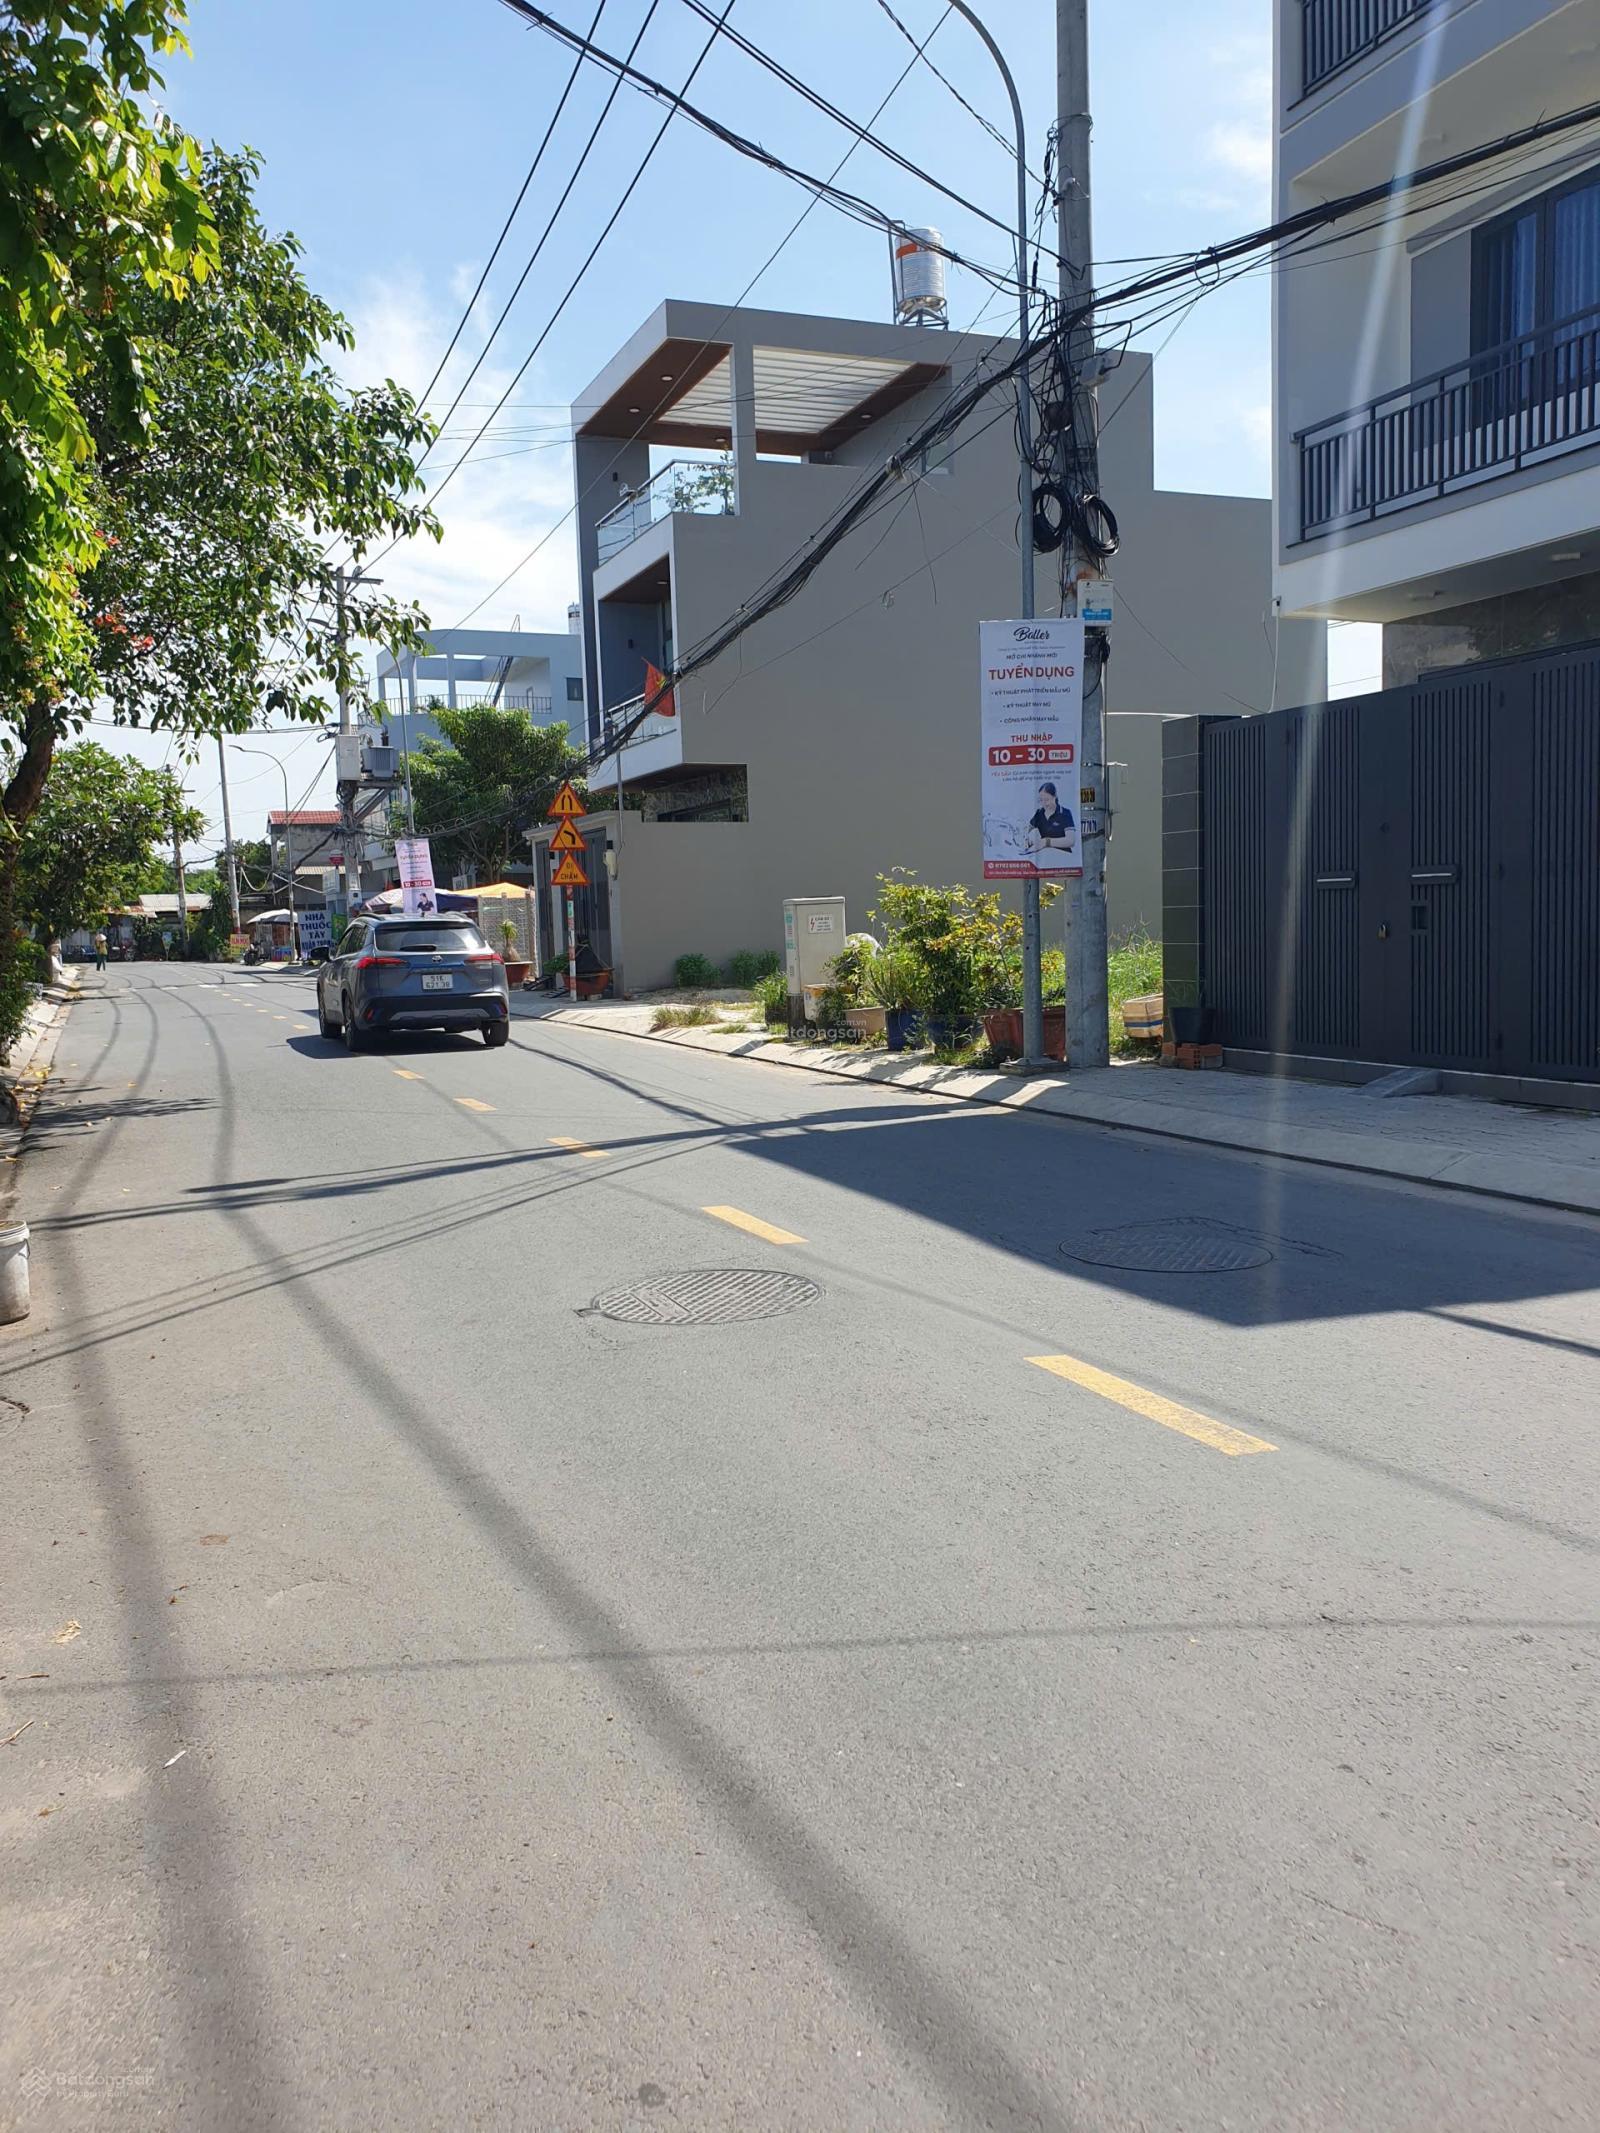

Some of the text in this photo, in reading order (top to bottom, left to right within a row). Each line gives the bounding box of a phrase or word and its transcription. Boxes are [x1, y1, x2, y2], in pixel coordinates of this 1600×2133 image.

[988, 662, 1075, 680] TUYỂN DỤNG
[1011, 732, 1053, 744] THU NHẬP
[993, 750, 1010, 763] 10
[1028, 748, 1045, 761] 30
[309, 930, 326, 939] TÂY
